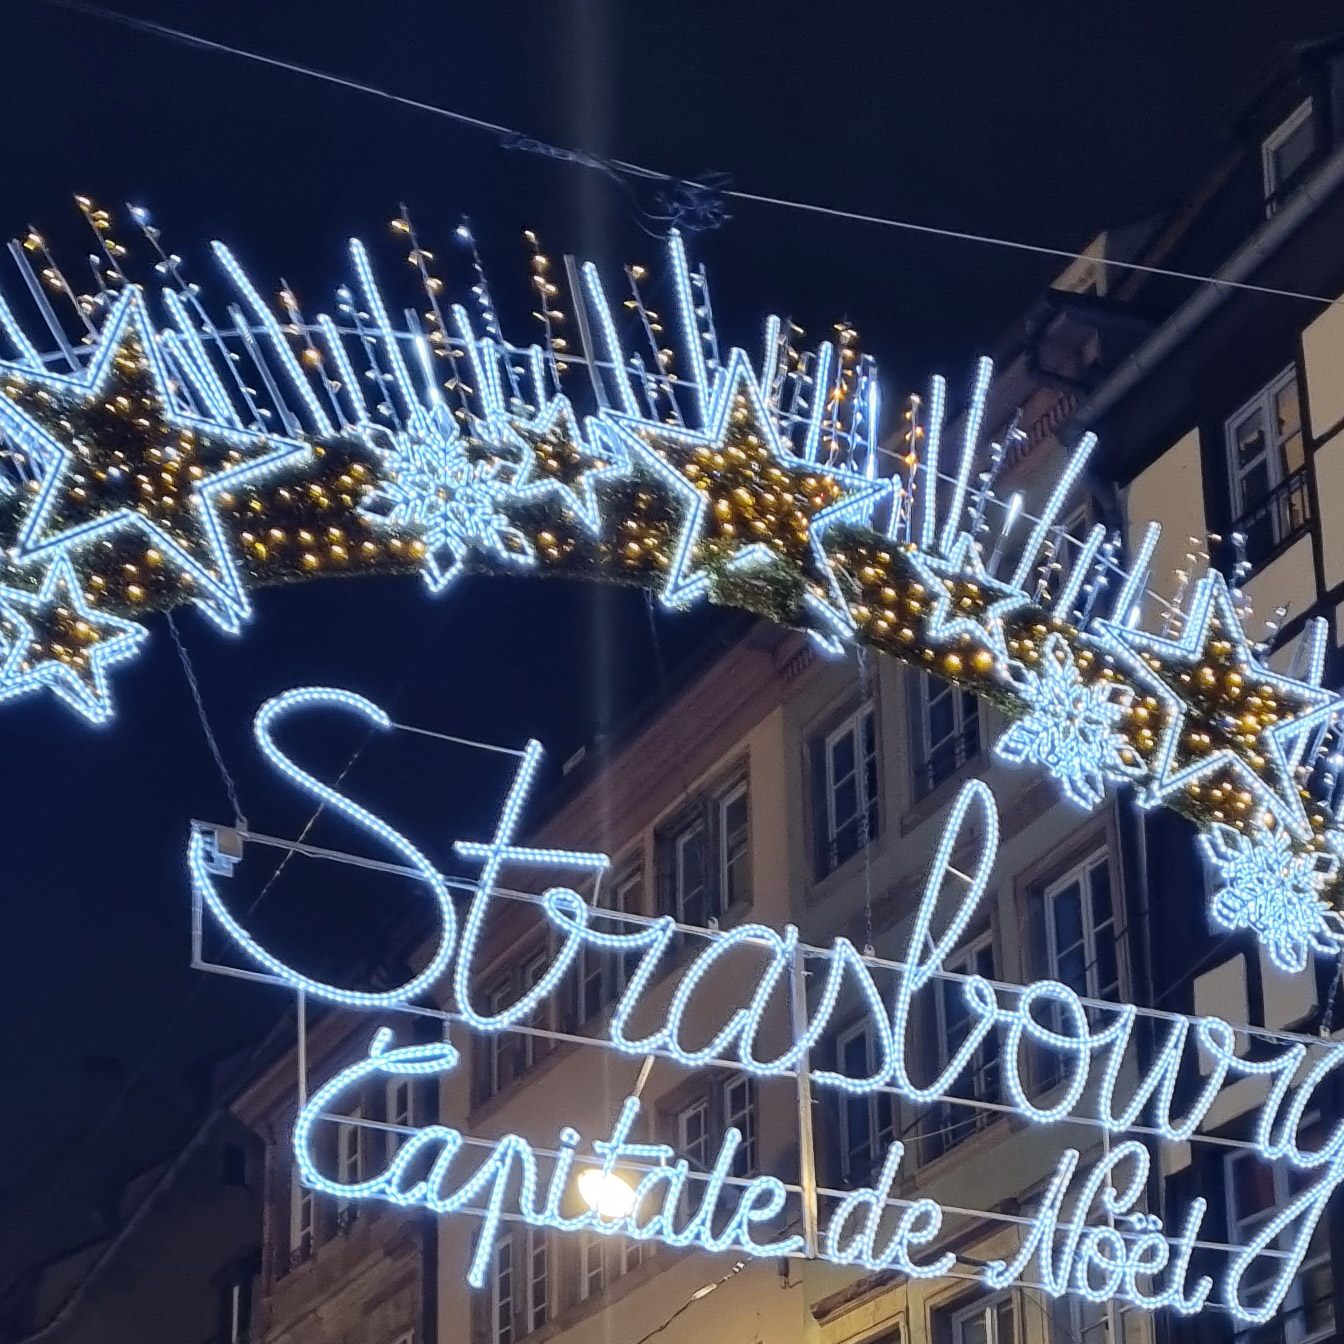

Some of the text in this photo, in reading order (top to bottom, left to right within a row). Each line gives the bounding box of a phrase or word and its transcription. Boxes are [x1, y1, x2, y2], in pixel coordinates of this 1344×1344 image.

[293, 1027, 1214, 1315] Capitale de Noël
